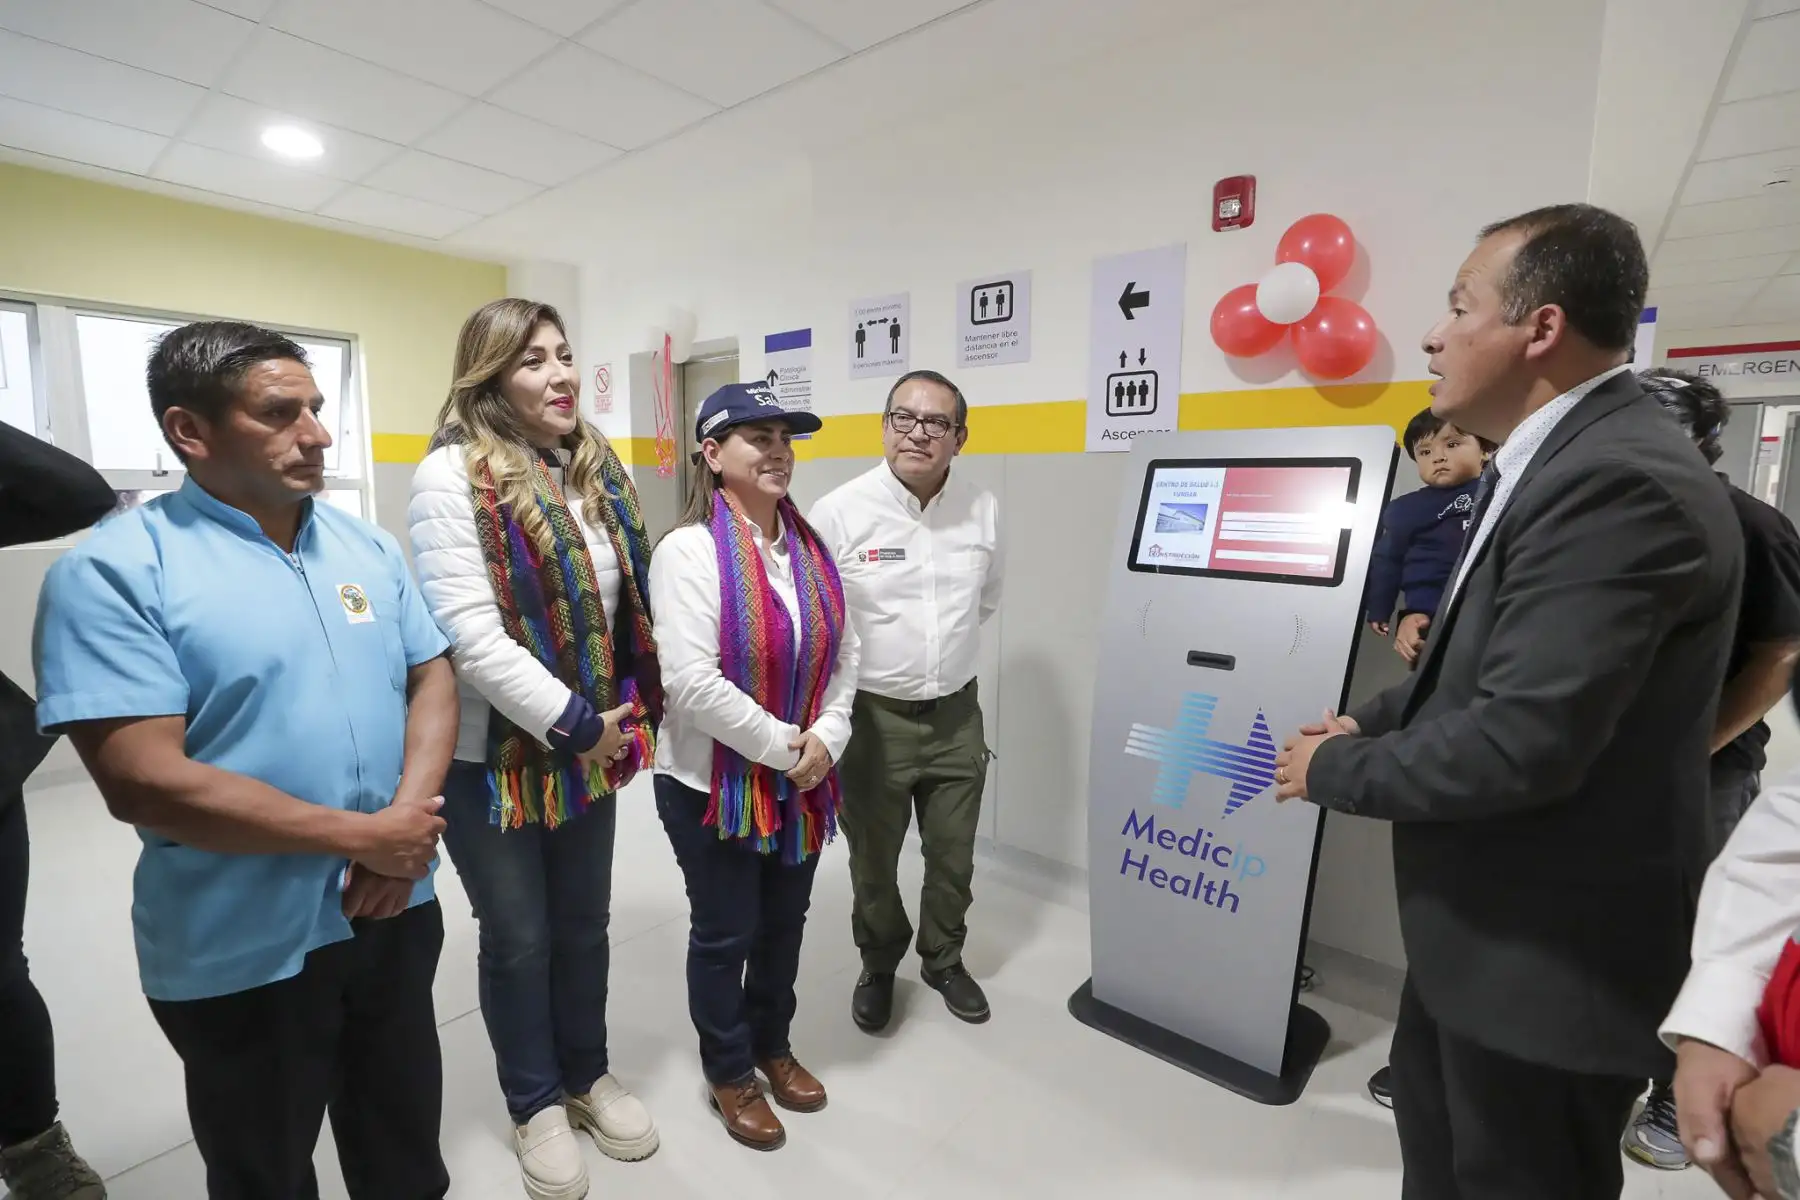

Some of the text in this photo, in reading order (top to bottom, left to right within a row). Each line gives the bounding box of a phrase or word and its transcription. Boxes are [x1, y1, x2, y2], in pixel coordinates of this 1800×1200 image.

[965, 333, 1000, 342] Mantener
[965, 343, 997, 351] distancia
[965, 353, 999, 361] ascensor
[1101, 428, 1171, 441] Asce
[1121, 808, 1266, 882] Medicip
[1120, 848, 1240, 913] Health
